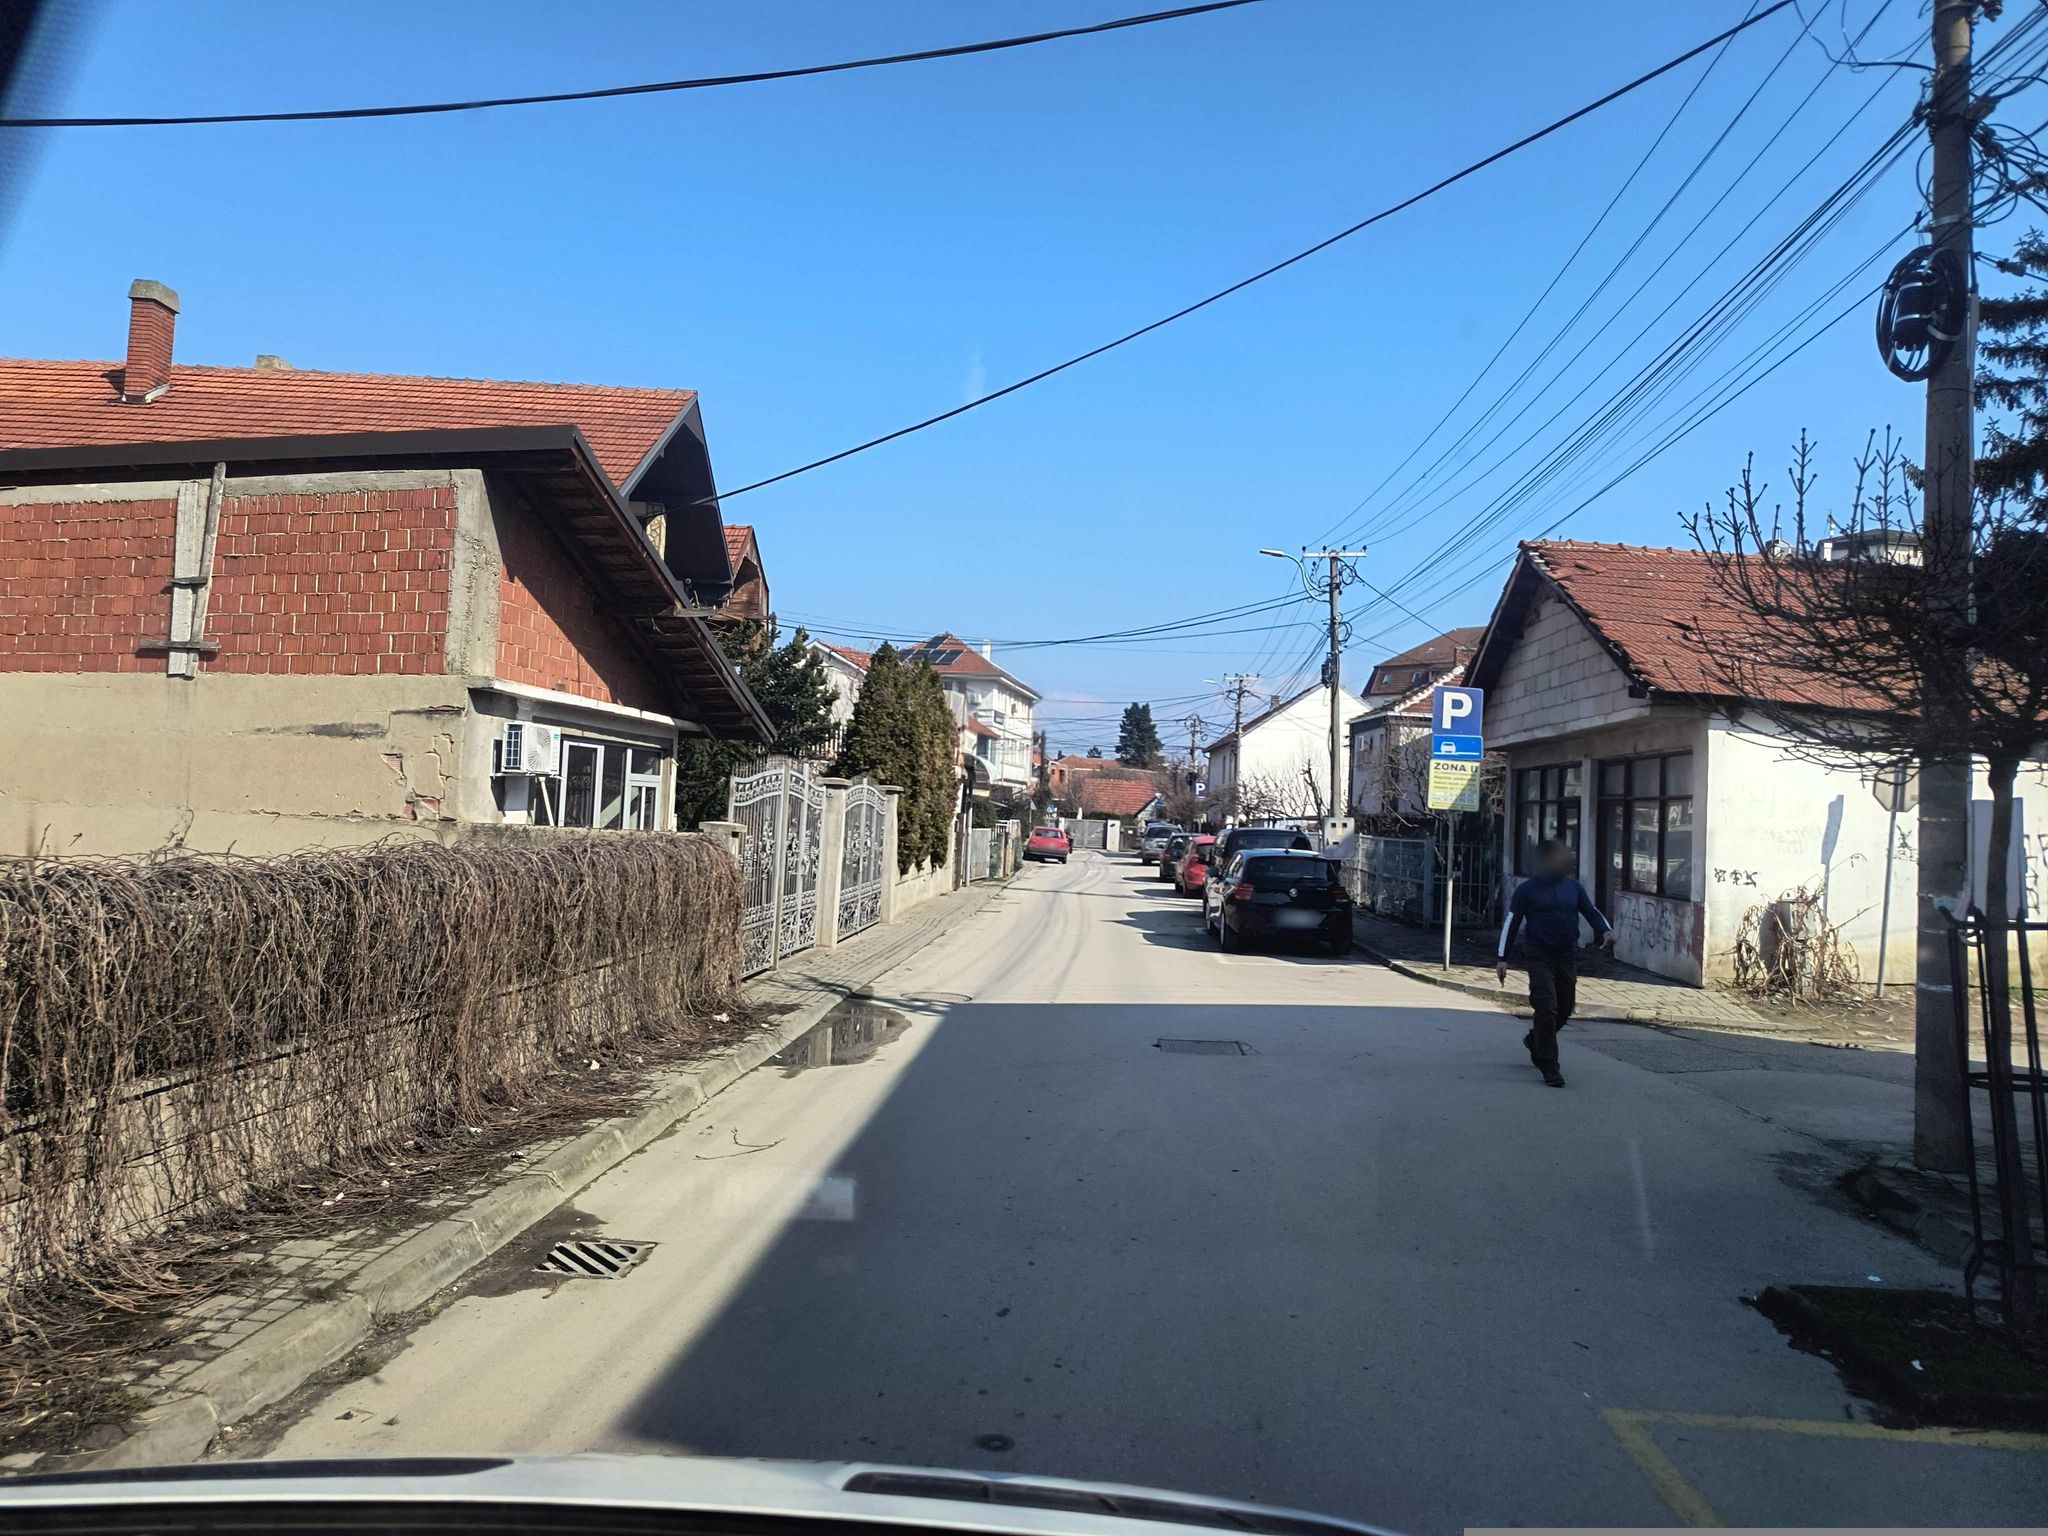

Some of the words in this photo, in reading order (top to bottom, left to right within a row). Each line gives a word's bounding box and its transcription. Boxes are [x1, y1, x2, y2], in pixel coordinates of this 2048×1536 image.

[1442, 691, 1472, 729] P
[1433, 762, 1466, 772] ZONA
[1196, 783, 1206, 795] P
